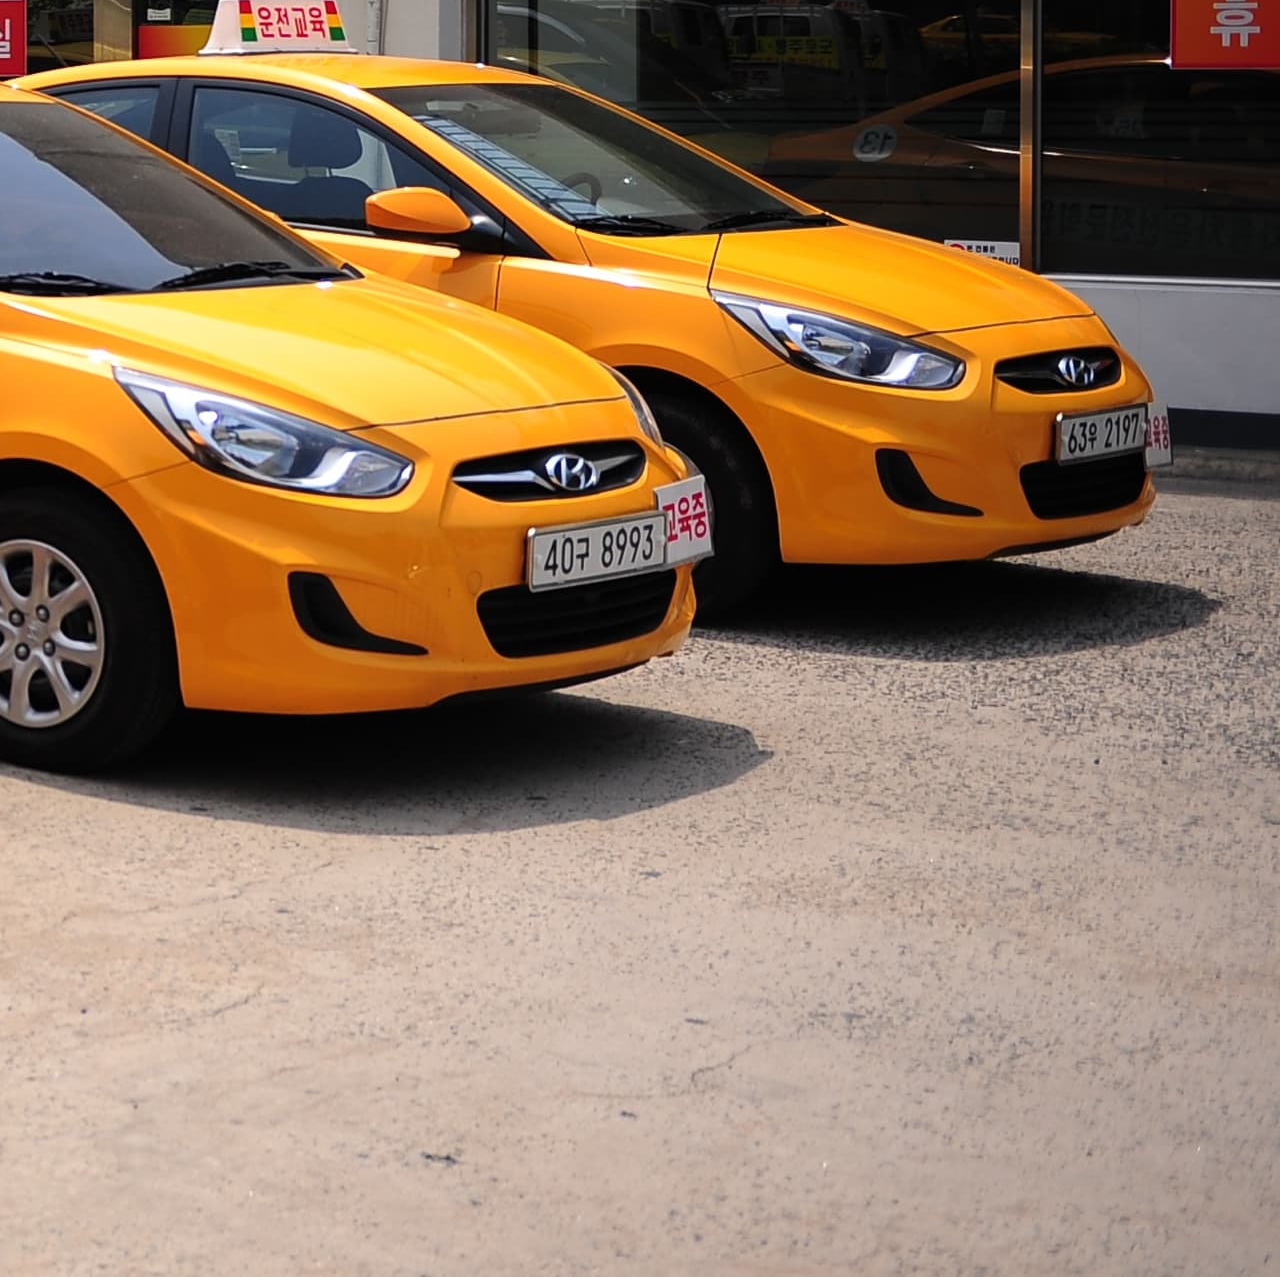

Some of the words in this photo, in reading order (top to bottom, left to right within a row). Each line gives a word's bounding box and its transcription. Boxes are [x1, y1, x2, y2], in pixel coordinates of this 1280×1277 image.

[257, 6, 327, 39] 운전교육
[1104, 412, 1140, 449] 2197
[662, 490, 708, 543] 교육중
[543, 536, 591, 578] 40구
[600, 523, 655, 569] 8993
